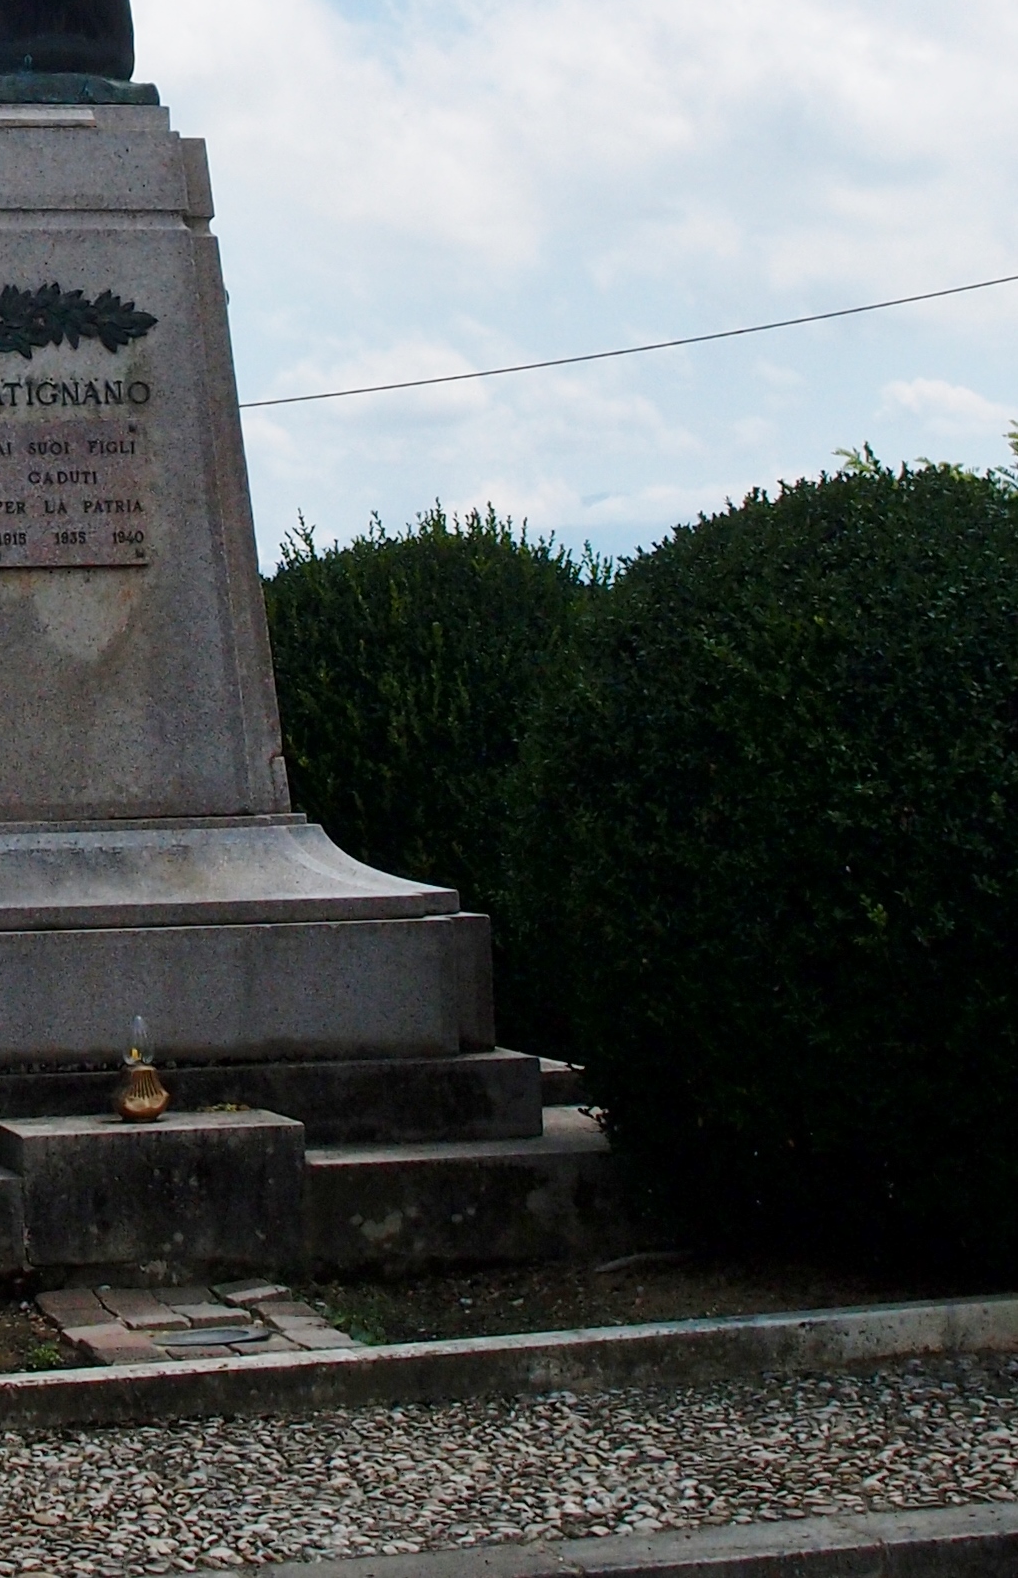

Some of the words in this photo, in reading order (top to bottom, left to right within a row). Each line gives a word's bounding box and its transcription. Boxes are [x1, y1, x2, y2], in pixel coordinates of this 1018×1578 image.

[28, 441, 71, 456] SUOI
[88, 440, 136, 455] FIGLI
[28, 471, 98, 485] CADUTI
[44, 500, 68, 514] LA
[83, 499, 144, 513] PATRIA
[55, 531, 87, 545] 1935
[112, 530, 144, 544] 1940
